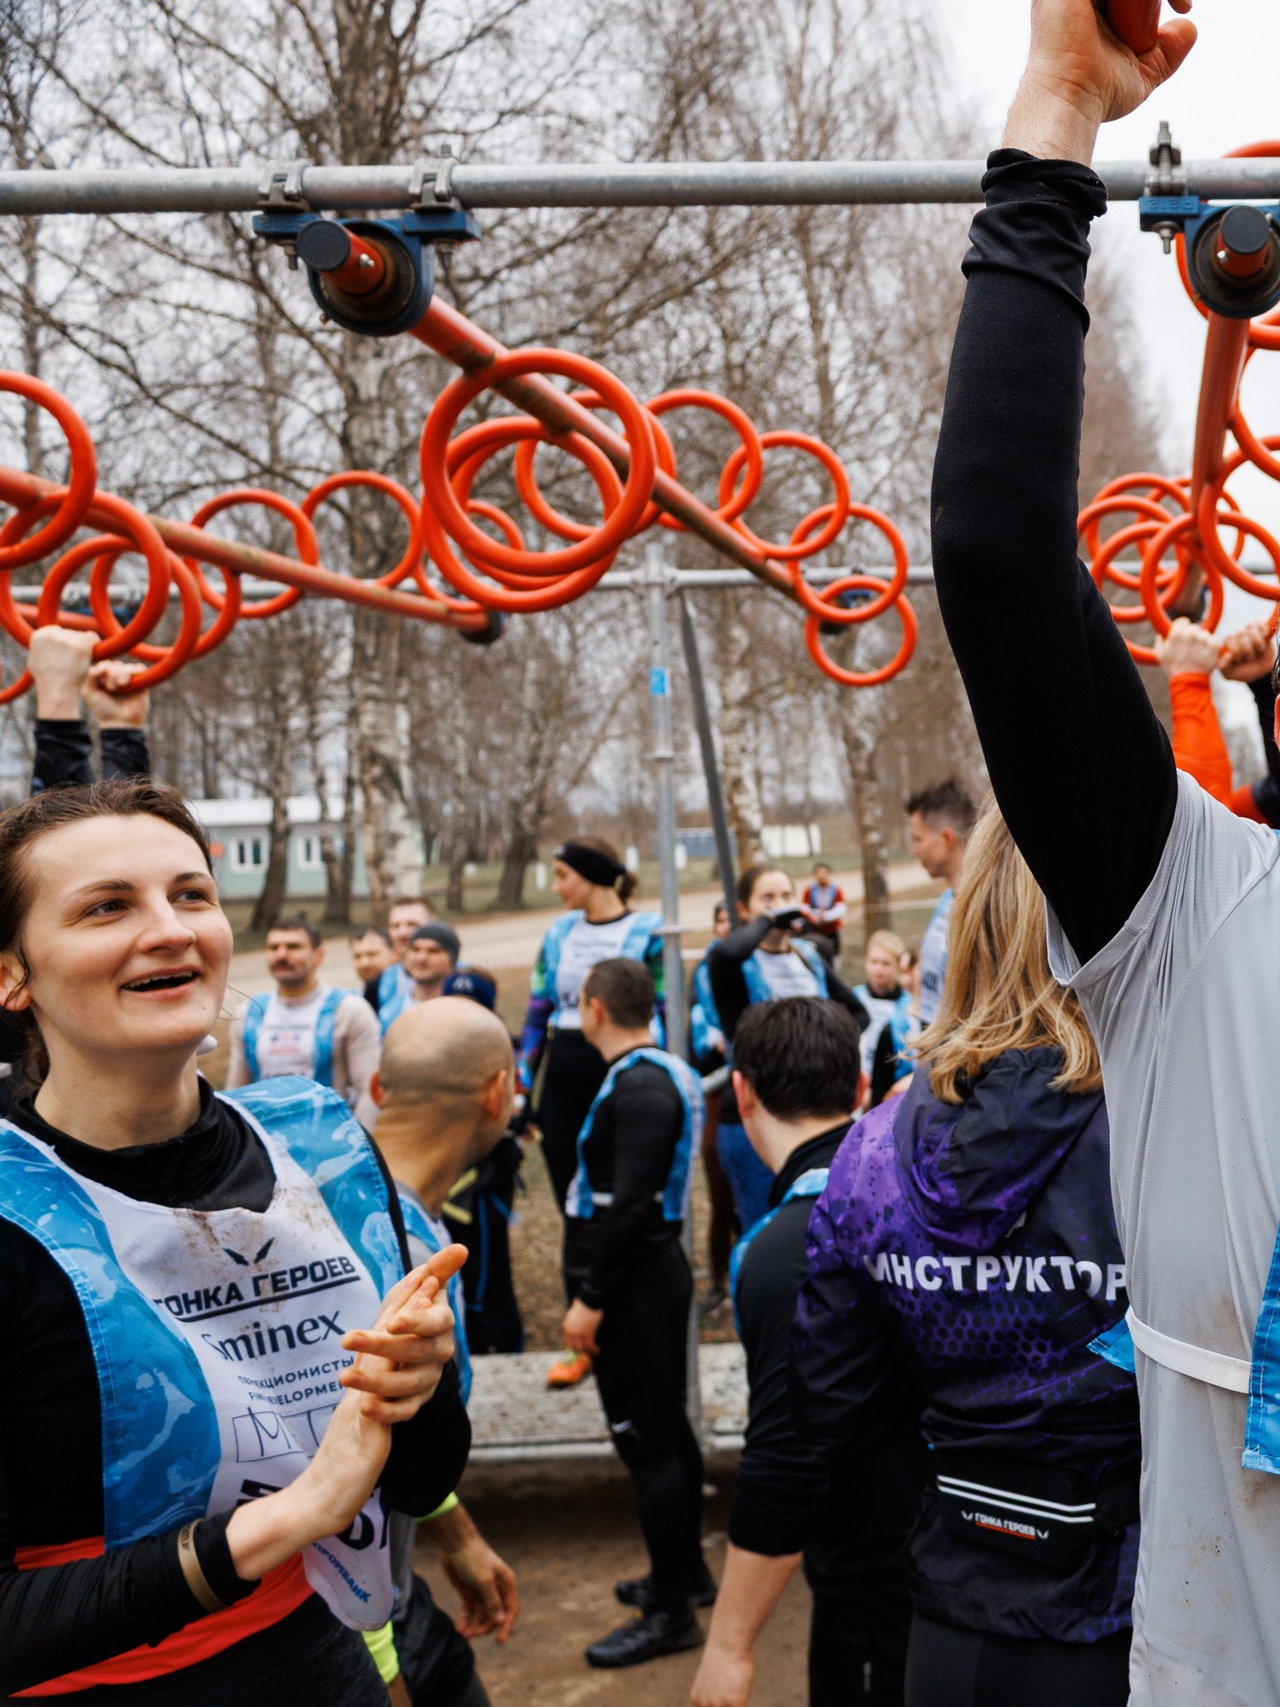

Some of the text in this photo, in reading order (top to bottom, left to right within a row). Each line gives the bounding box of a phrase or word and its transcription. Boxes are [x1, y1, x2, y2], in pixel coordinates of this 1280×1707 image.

[253, 1256, 356, 1297] ГЕРОЕВ
[863, 1252, 1126, 1301] ИНСТРУКТОР
[313, 1541, 372, 1603] ПРОМБАНК
